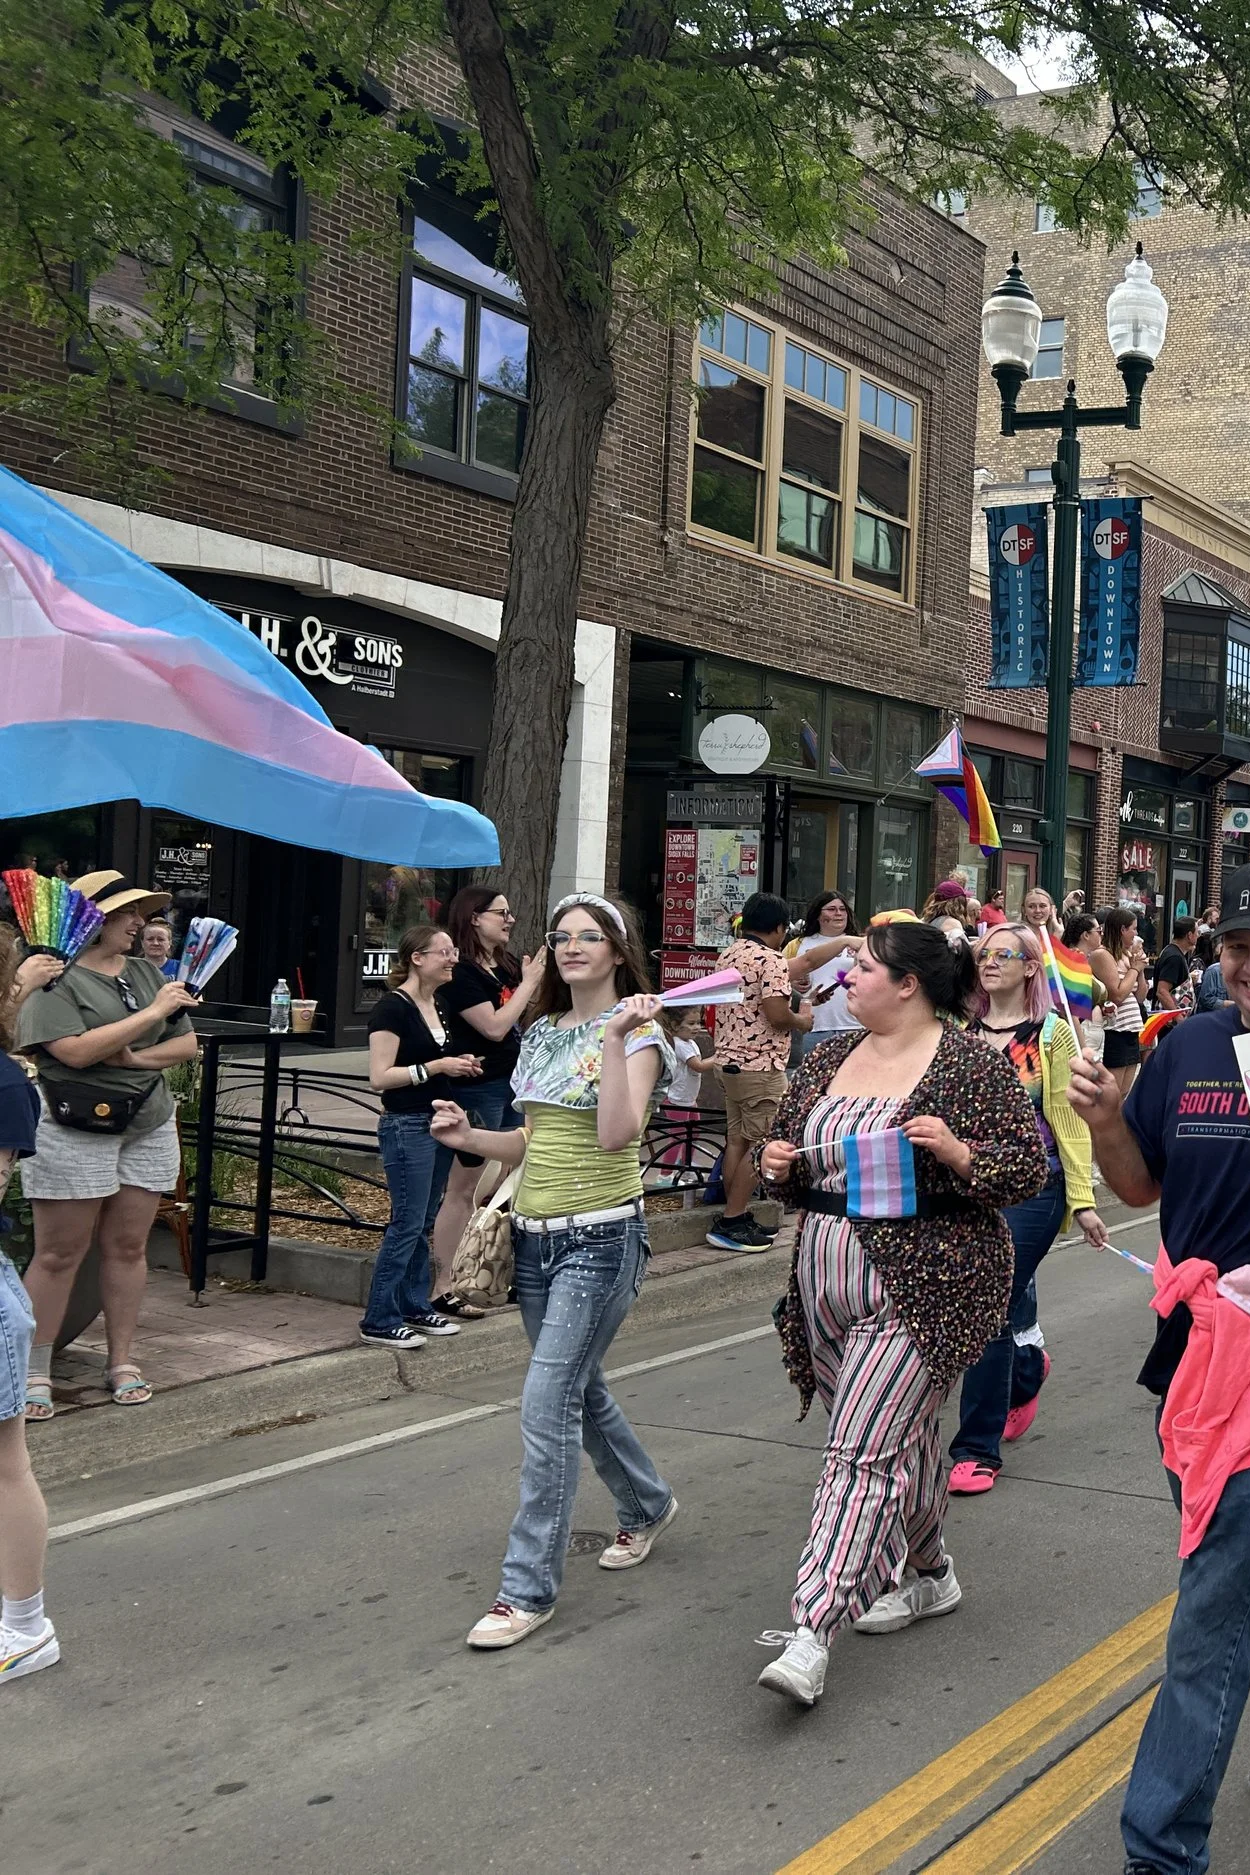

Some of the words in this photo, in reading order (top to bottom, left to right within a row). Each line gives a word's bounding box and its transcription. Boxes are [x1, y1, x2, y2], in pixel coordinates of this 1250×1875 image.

[1002, 537, 1034, 552] DTSF
[1096, 532, 1127, 546] DTSF
[1016, 570, 1024, 672] HISTORIC
[1103, 566, 1115, 672] DOWNTOWN
[241, 612, 288, 657] H.
[295, 616, 354, 685] &
[353, 636, 403, 668] SONS
[351, 664, 386, 678] CLOTHIER
[675, 797, 754, 816] INFORMATION
[1012, 823, 1023, 834] 220
[669, 834, 695, 844] EXPLORE
[1123, 845, 1152, 870] SALE
[363, 953, 393, 975] J.H.
[689, 955, 716, 968] Welcom
[664, 967, 706, 980] DOWNTOWN
[1178, 1092, 1233, 1115] SOUTH
